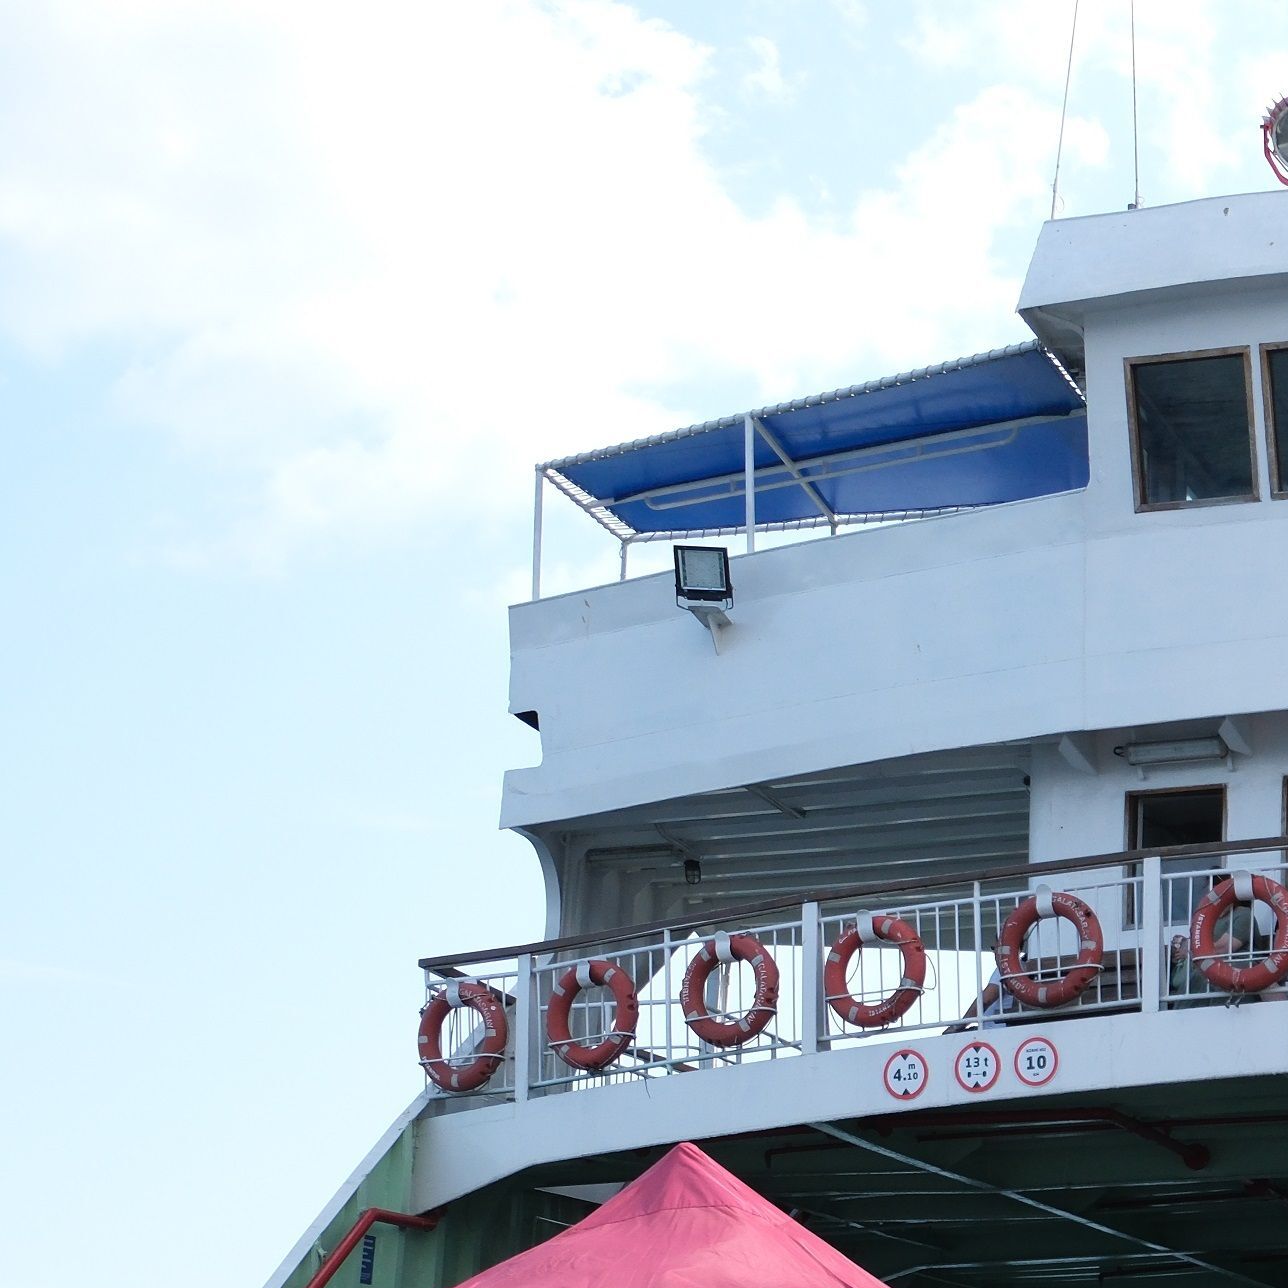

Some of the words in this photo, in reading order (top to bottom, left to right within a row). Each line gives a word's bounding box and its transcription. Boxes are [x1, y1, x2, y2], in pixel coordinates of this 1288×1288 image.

[965, 1057, 980, 1068] 13
[983, 1057, 989, 1067] t
[1026, 1055, 1047, 1070] 10
[893, 1068, 919, 1081] 4.10
